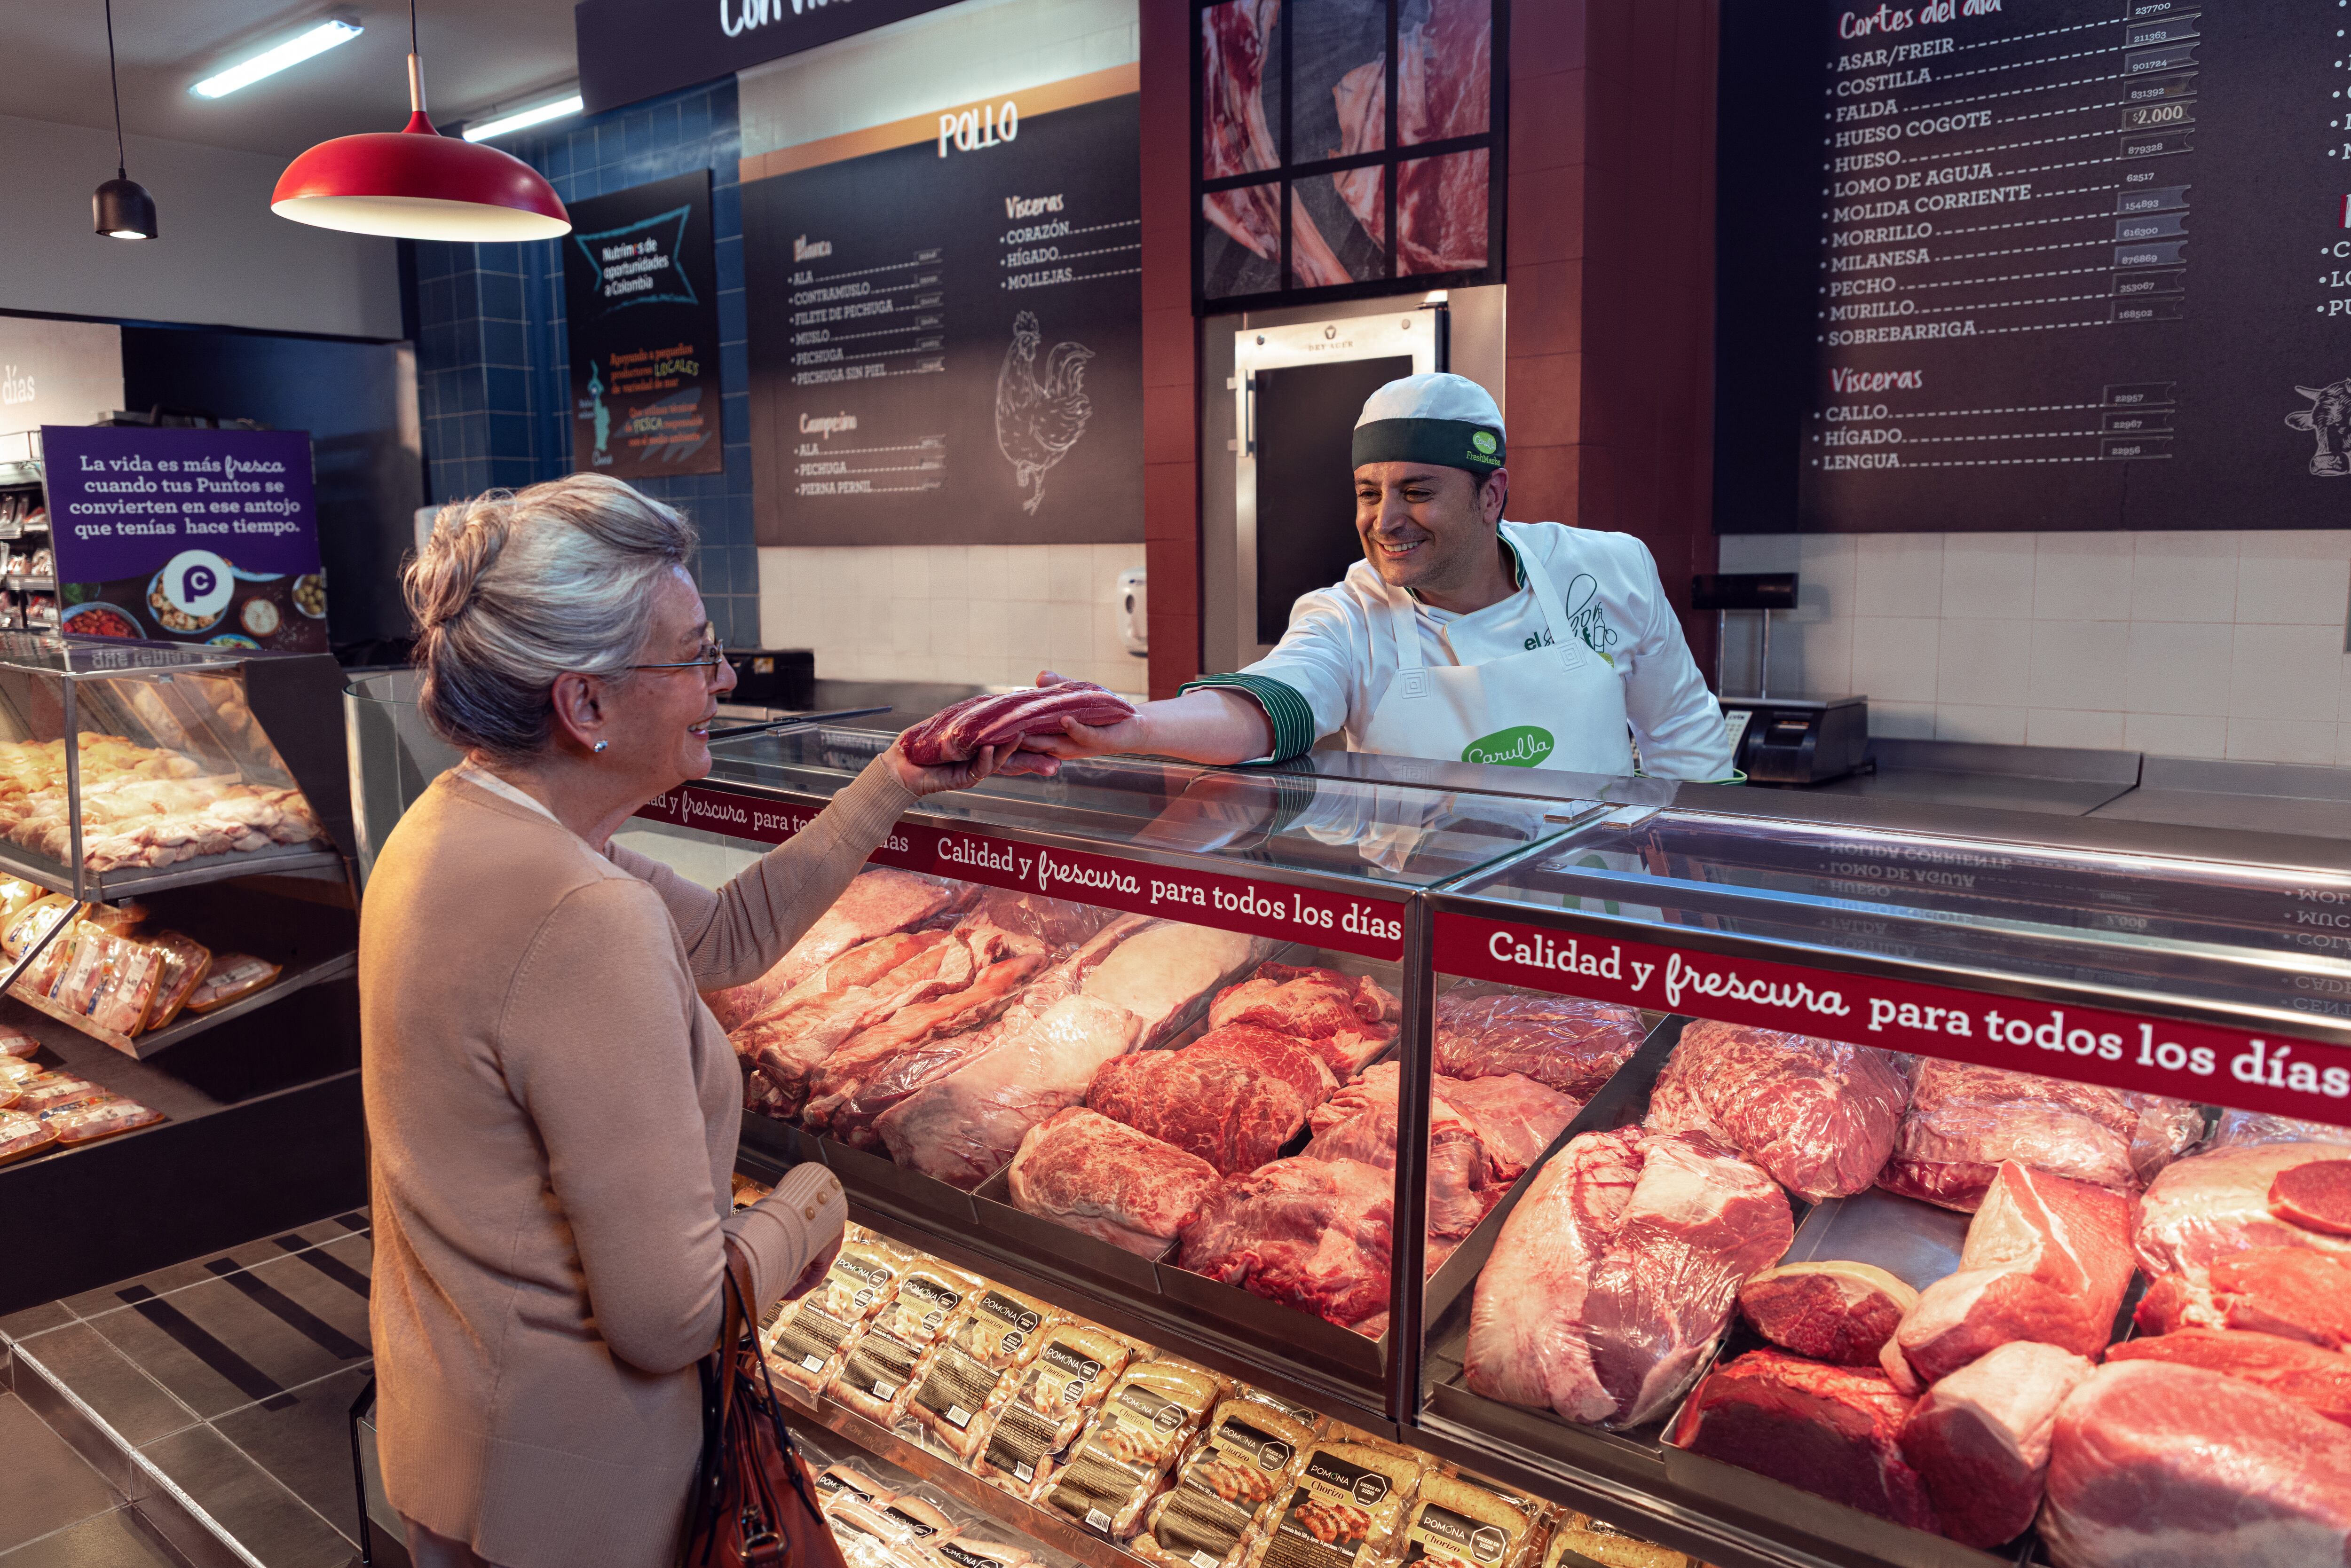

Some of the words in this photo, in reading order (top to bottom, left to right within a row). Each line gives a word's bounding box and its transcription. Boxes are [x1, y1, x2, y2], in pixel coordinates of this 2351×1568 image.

[2135, 3, 2170, 15] 237700
[1838, 3, 1914, 39] Cortes
[1919, 0, 1956, 24] del
[2134, 32, 2166, 43] 211363
[1836, 38, 1954, 72] ASAR/FREIR
[2133, 60, 2167, 71] 901724
[1836, 68, 1932, 96] COSTILLA
[2131, 88, 2164, 99] 831392
[1836, 99, 1898, 122] FALDA
[2133, 106, 2183, 124] $2.000
[938, 100, 1019, 158] POLLO
[1835, 125, 1901, 148] HUESO
[1906, 110, 1992, 137] COGOTE
[2128, 143, 2163, 155] 879328
[1835, 150, 1901, 173] HUESO
[1834, 176, 1891, 198] LOMO
[1895, 173, 1921, 190] DE
[1925, 163, 1993, 186] AGUJA
[2126, 173, 2154, 182] 62517
[1833, 200, 1910, 223] MOLIDA
[1915, 184, 2031, 213] CORRIENTE
[2125, 200, 2159, 210] 154893
[1007, 218, 1070, 244] CORAZÓN
[1832, 222, 1933, 248] MORRILLO
[2124, 227, 2158, 237] 616300
[1007, 247, 1059, 268] HÍGADO
[1830, 248, 1931, 273] MILANESA
[603, 253, 669, 281] oportunidades
[611, 274, 653, 295] Colombia
[793, 270, 813, 286] ALA
[1008, 267, 1072, 290] MOLLEJAS
[1830, 276, 1896, 297] PECHO
[794, 282, 870, 306] CONTRAMUSLO
[2120, 282, 2154, 293] 353067
[795, 308, 828, 325] FILETE
[828, 307, 843, 322] DE
[844, 299, 893, 318] PECHUGA
[1830, 299, 1915, 321] MURILLO
[2119, 309, 2153, 319] 168502
[795, 329, 830, 346] MUSLO
[1828, 320, 1976, 347] SOBREBARRIGA
[796, 347, 844, 365] PECHUGA
[655, 358, 699, 376] LOCALES
[797, 368, 844, 386] PECHUGA
[846, 365, 863, 380] SIN
[864, 363, 887, 378] PIEL
[3, 365, 35, 405] días
[1829, 367, 1922, 393] Vísceras
[1825, 404, 1888, 422] CALLO
[1824, 425, 1902, 446] HÍGADO
[799, 443, 819, 457] ALA
[80, 456, 105, 472] La
[110, 456, 153, 472] vida
[158, 460, 179, 472] es
[183, 456, 222, 471] más
[225, 455, 285, 480] fresca
[800, 461, 846, 476] PECHUGA
[1823, 453, 1901, 470] LENGUA
[84, 476, 158, 493] cuando
[161, 480, 192, 492] tus
[197, 477, 260, 492] Puntos
[265, 481, 284, 492] se
[800, 482, 836, 496] PIERNA
[837, 480, 870, 494] PERNIL
[70, 498, 179, 514] convierten
[182, 502, 206, 513] en
[210, 502, 240, 513] ese
[245, 498, 300, 516] antojo
[75, 523, 111, 540] que
[116, 519, 176, 535] tenías
[185, 518, 229, 534] hace
[233, 520, 300, 536] tiempo.
[1468, 734, 1551, 764] Carulla
[669, 796, 678, 815] y
[682, 790, 748, 823] frescura
[753, 811, 789, 832] para
[938, 837, 1014, 872] Calidad
[1019, 857, 1032, 881] y
[1038, 851, 1141, 894] frescura
[1151, 880, 1207, 906] para
[1212, 886, 1286, 920] todos
[1293, 893, 1334, 928] los
[1341, 903, 1402, 941] días
[1489, 931, 1623, 981] Calidad
[1630, 961, 1655, 991] y
[1665, 952, 1850, 1016] frescura
[1868, 997, 1972, 1037] para
[1984, 1010, 2123, 1061] todos
[2137, 1023, 2216, 1076] los
[2230, 1040, 2351, 1098] días
[836, 1273, 856, 1287] Chorizo
[903, 1297, 924, 1310] Chorizo
[980, 1314, 1003, 1330] Chorizo
[1043, 1365, 1066, 1379] Chorizo
[1119, 1409, 1144, 1426] Chorizo
[1222, 1442, 1250, 1462] Chorizo
[1265, 1447, 1279, 1457] EXCESO
[1266, 1454, 1278, 1462] SODIO
[1311, 1481, 1344, 1499] Chorizo
[1311, 1494, 1334, 1505] parrillero
[1279, 1523, 1294, 1533] Contenido
[1323, 1542, 1338, 1551] porciones
[1341, 1548, 1355, 1557] Unidades
[1424, 1533, 1460, 1552] Chorizo
[1476, 1536, 1493, 1544] EXCESO
[1479, 1543, 1494, 1552] SODIO
[1426, 1547, 1450, 1559] parrillero
